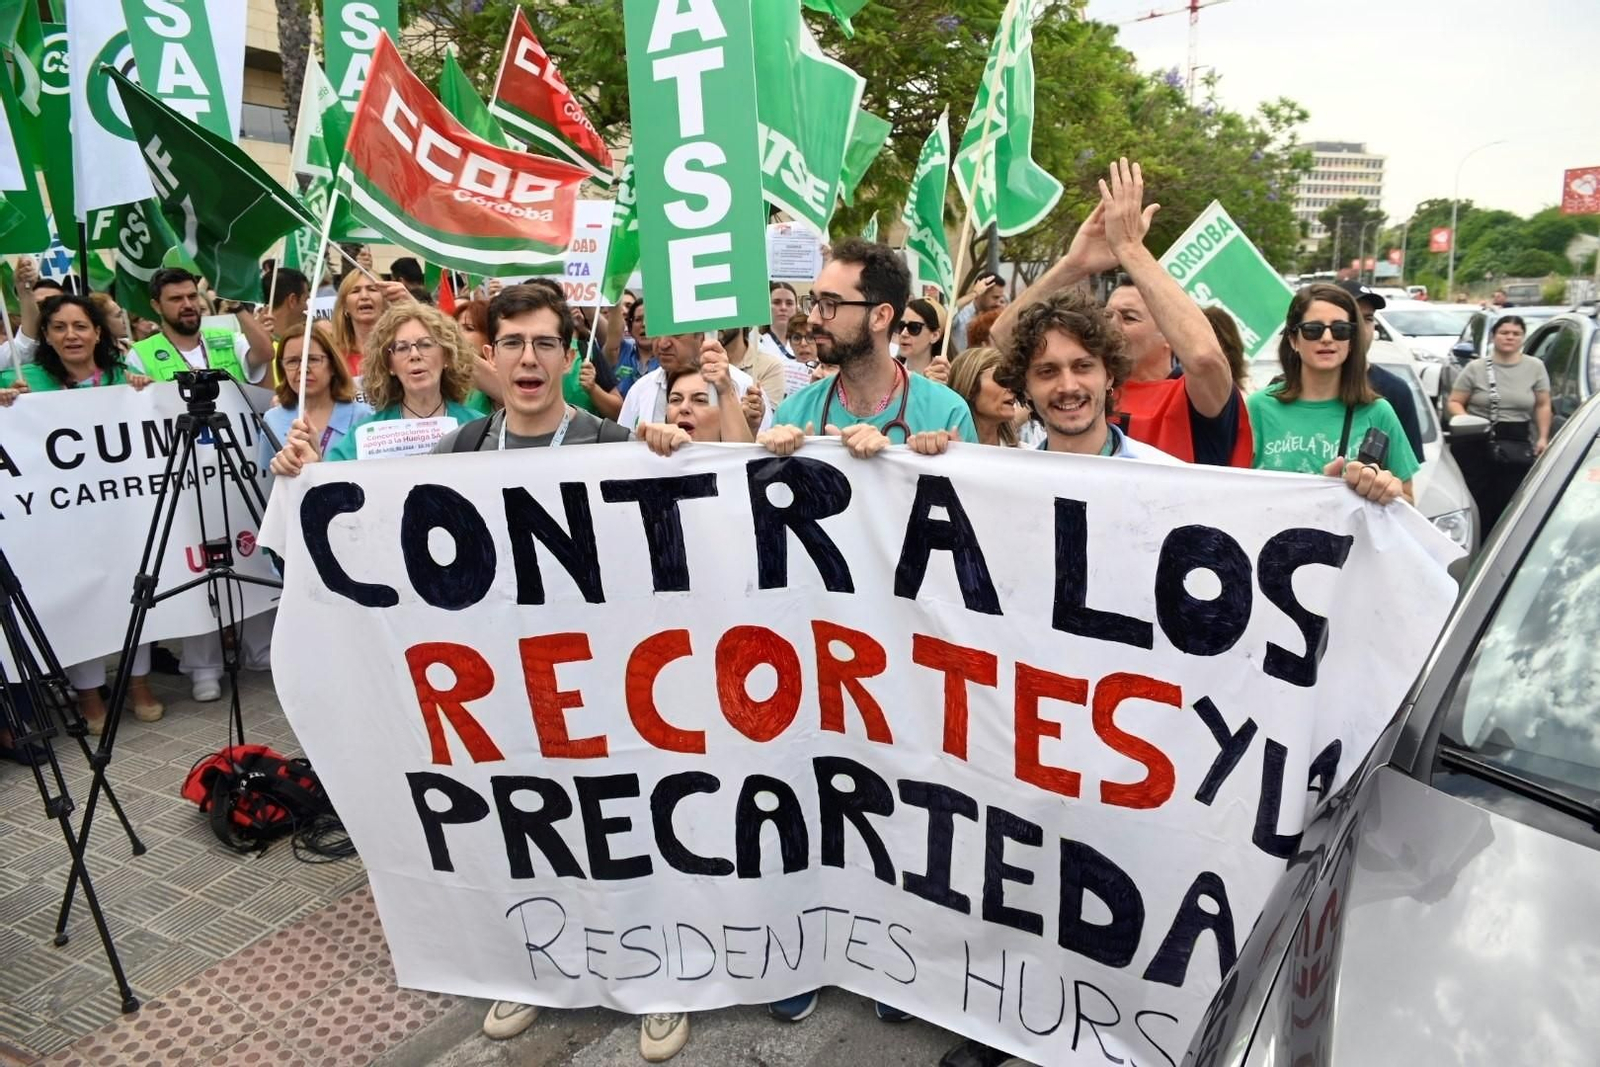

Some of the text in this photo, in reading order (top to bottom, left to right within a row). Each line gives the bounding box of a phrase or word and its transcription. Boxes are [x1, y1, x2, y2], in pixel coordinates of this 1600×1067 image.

[381, 86, 562, 203] CCOO
[15, 492, 34, 515] Y
[299, 456, 1354, 687] CONTRA LOS
[404, 619, 1182, 810] RECORTES
[1193, 696, 1259, 805] Y
[506, 897, 916, 985] RESIDENTES
